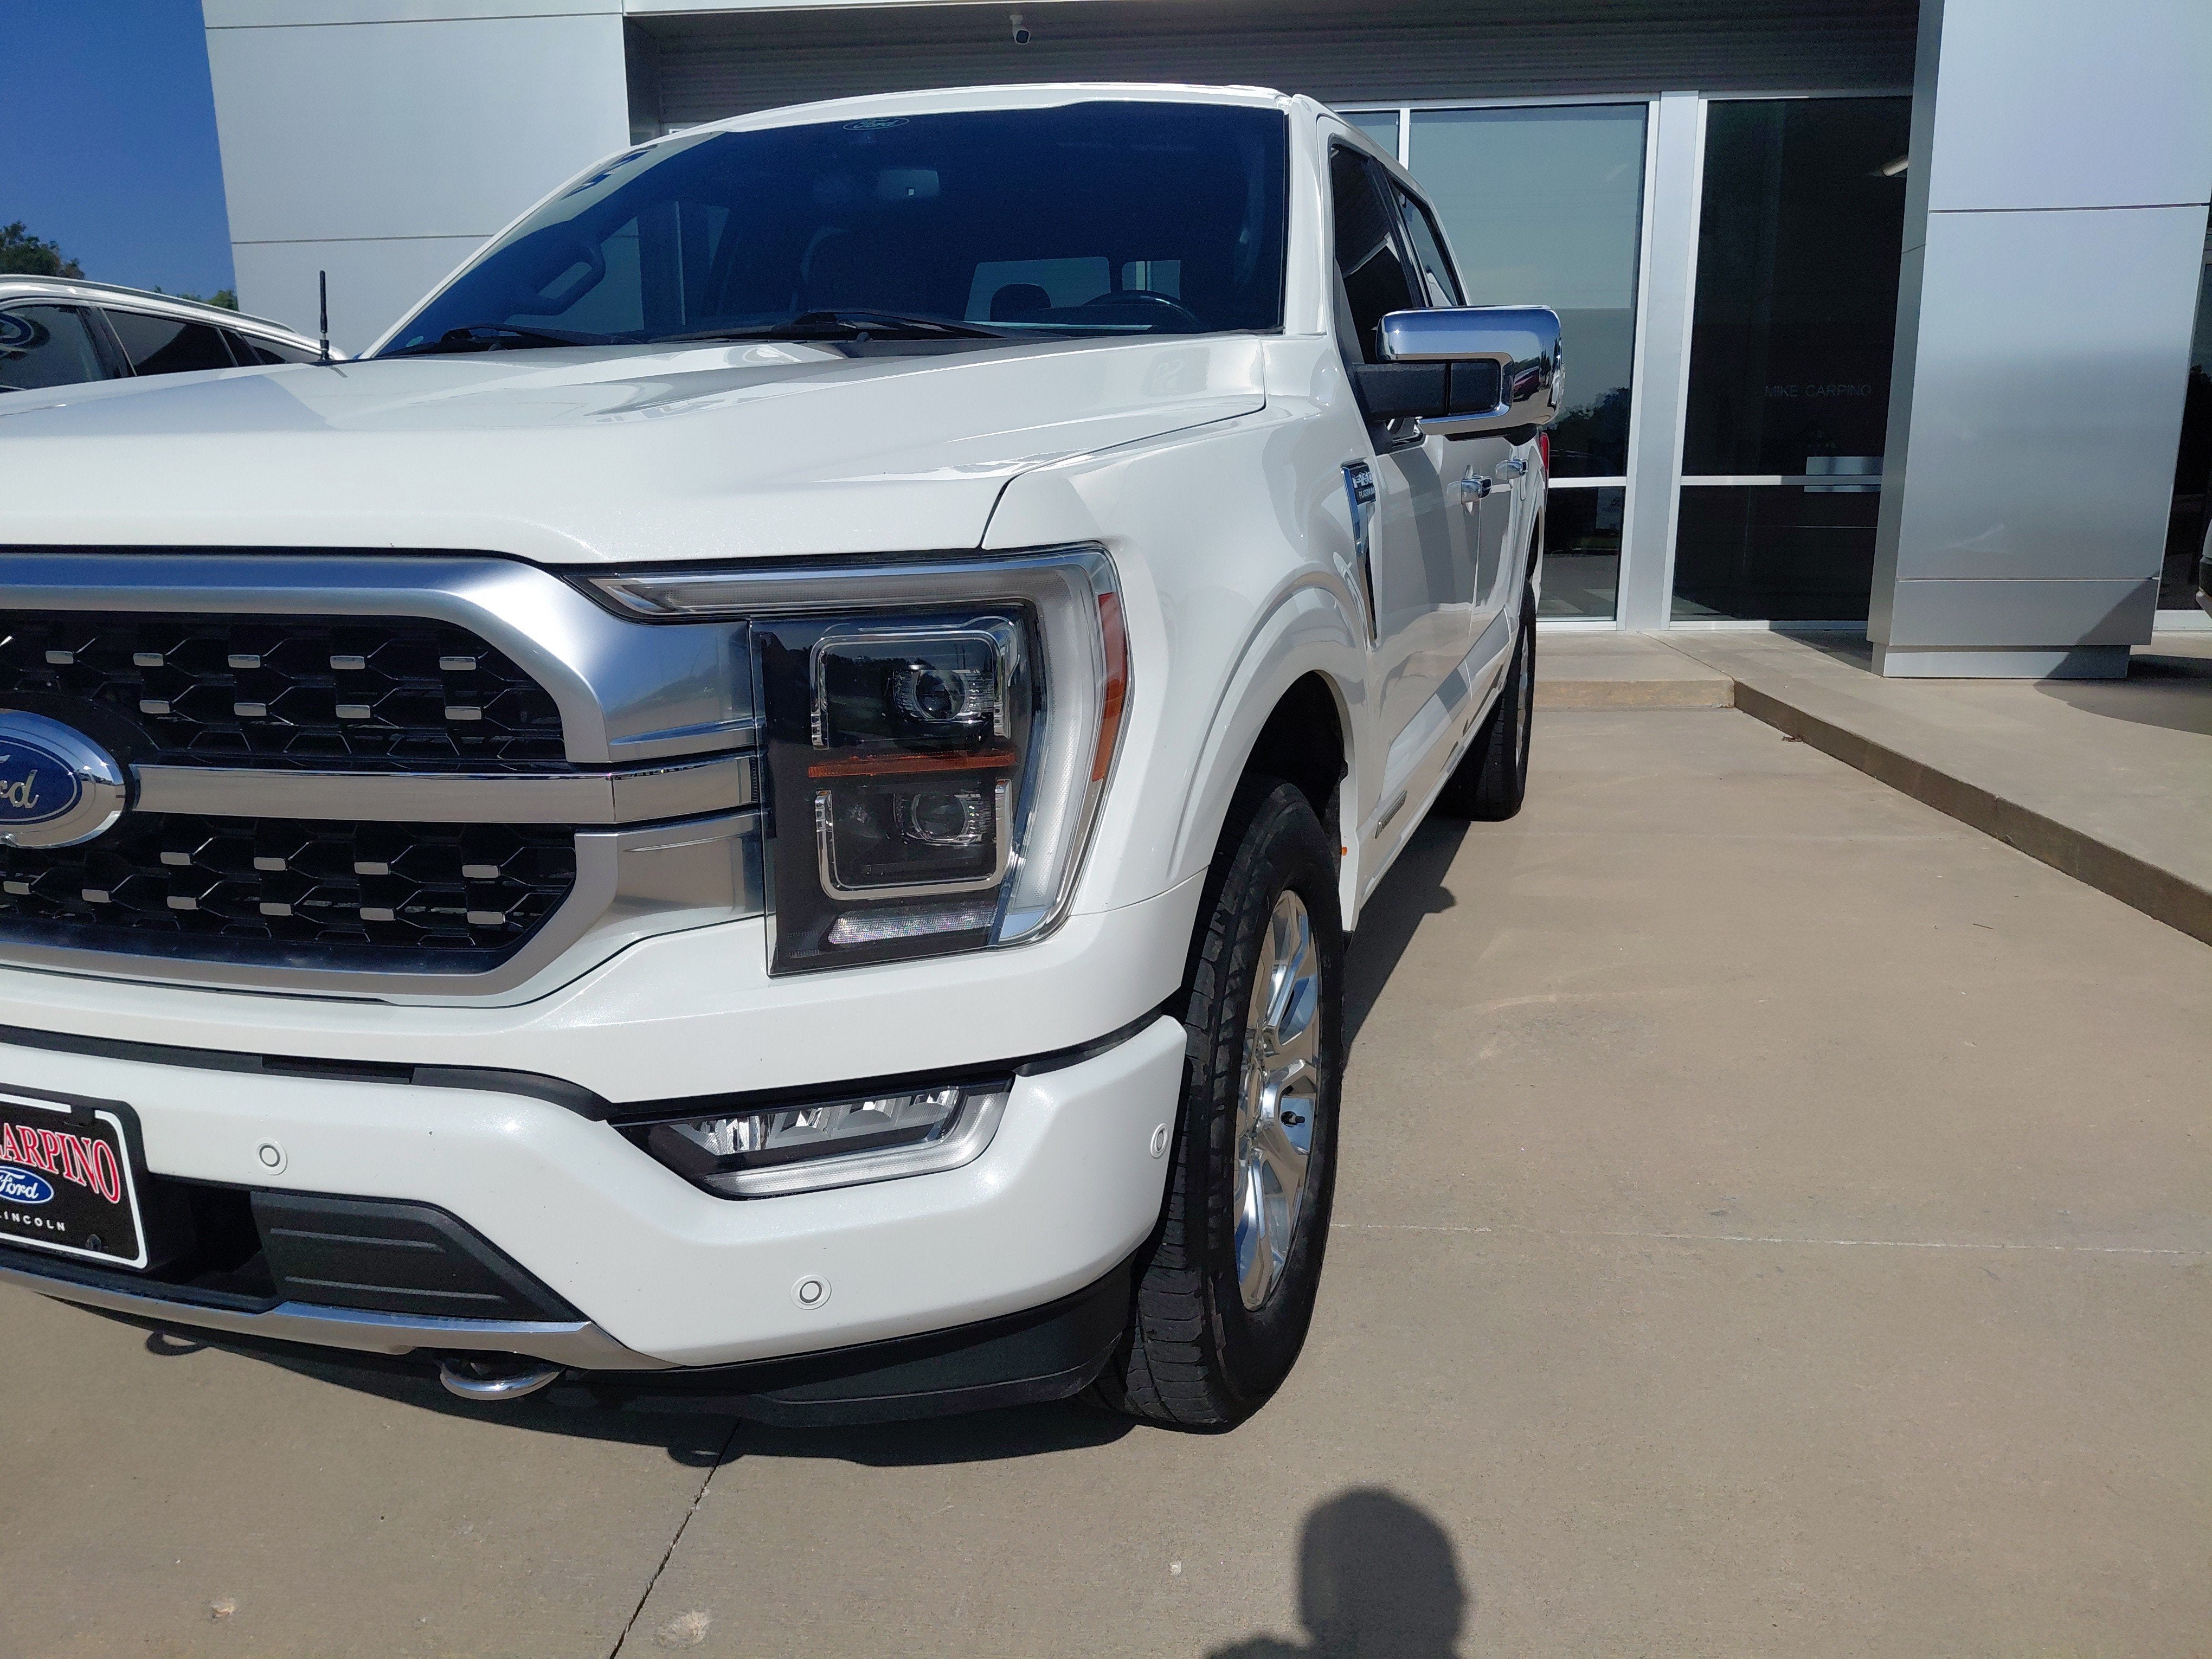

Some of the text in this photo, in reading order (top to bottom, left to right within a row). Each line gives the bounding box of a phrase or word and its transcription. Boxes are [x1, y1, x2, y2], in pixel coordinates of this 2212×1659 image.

[1764, 384, 1872, 397] MIKE CARPINO
[0, 1123, 121, 1204] ARPINO
[0, 1169, 40, 1200] Ford
[0, 1211, 66, 1232] INCOLN
